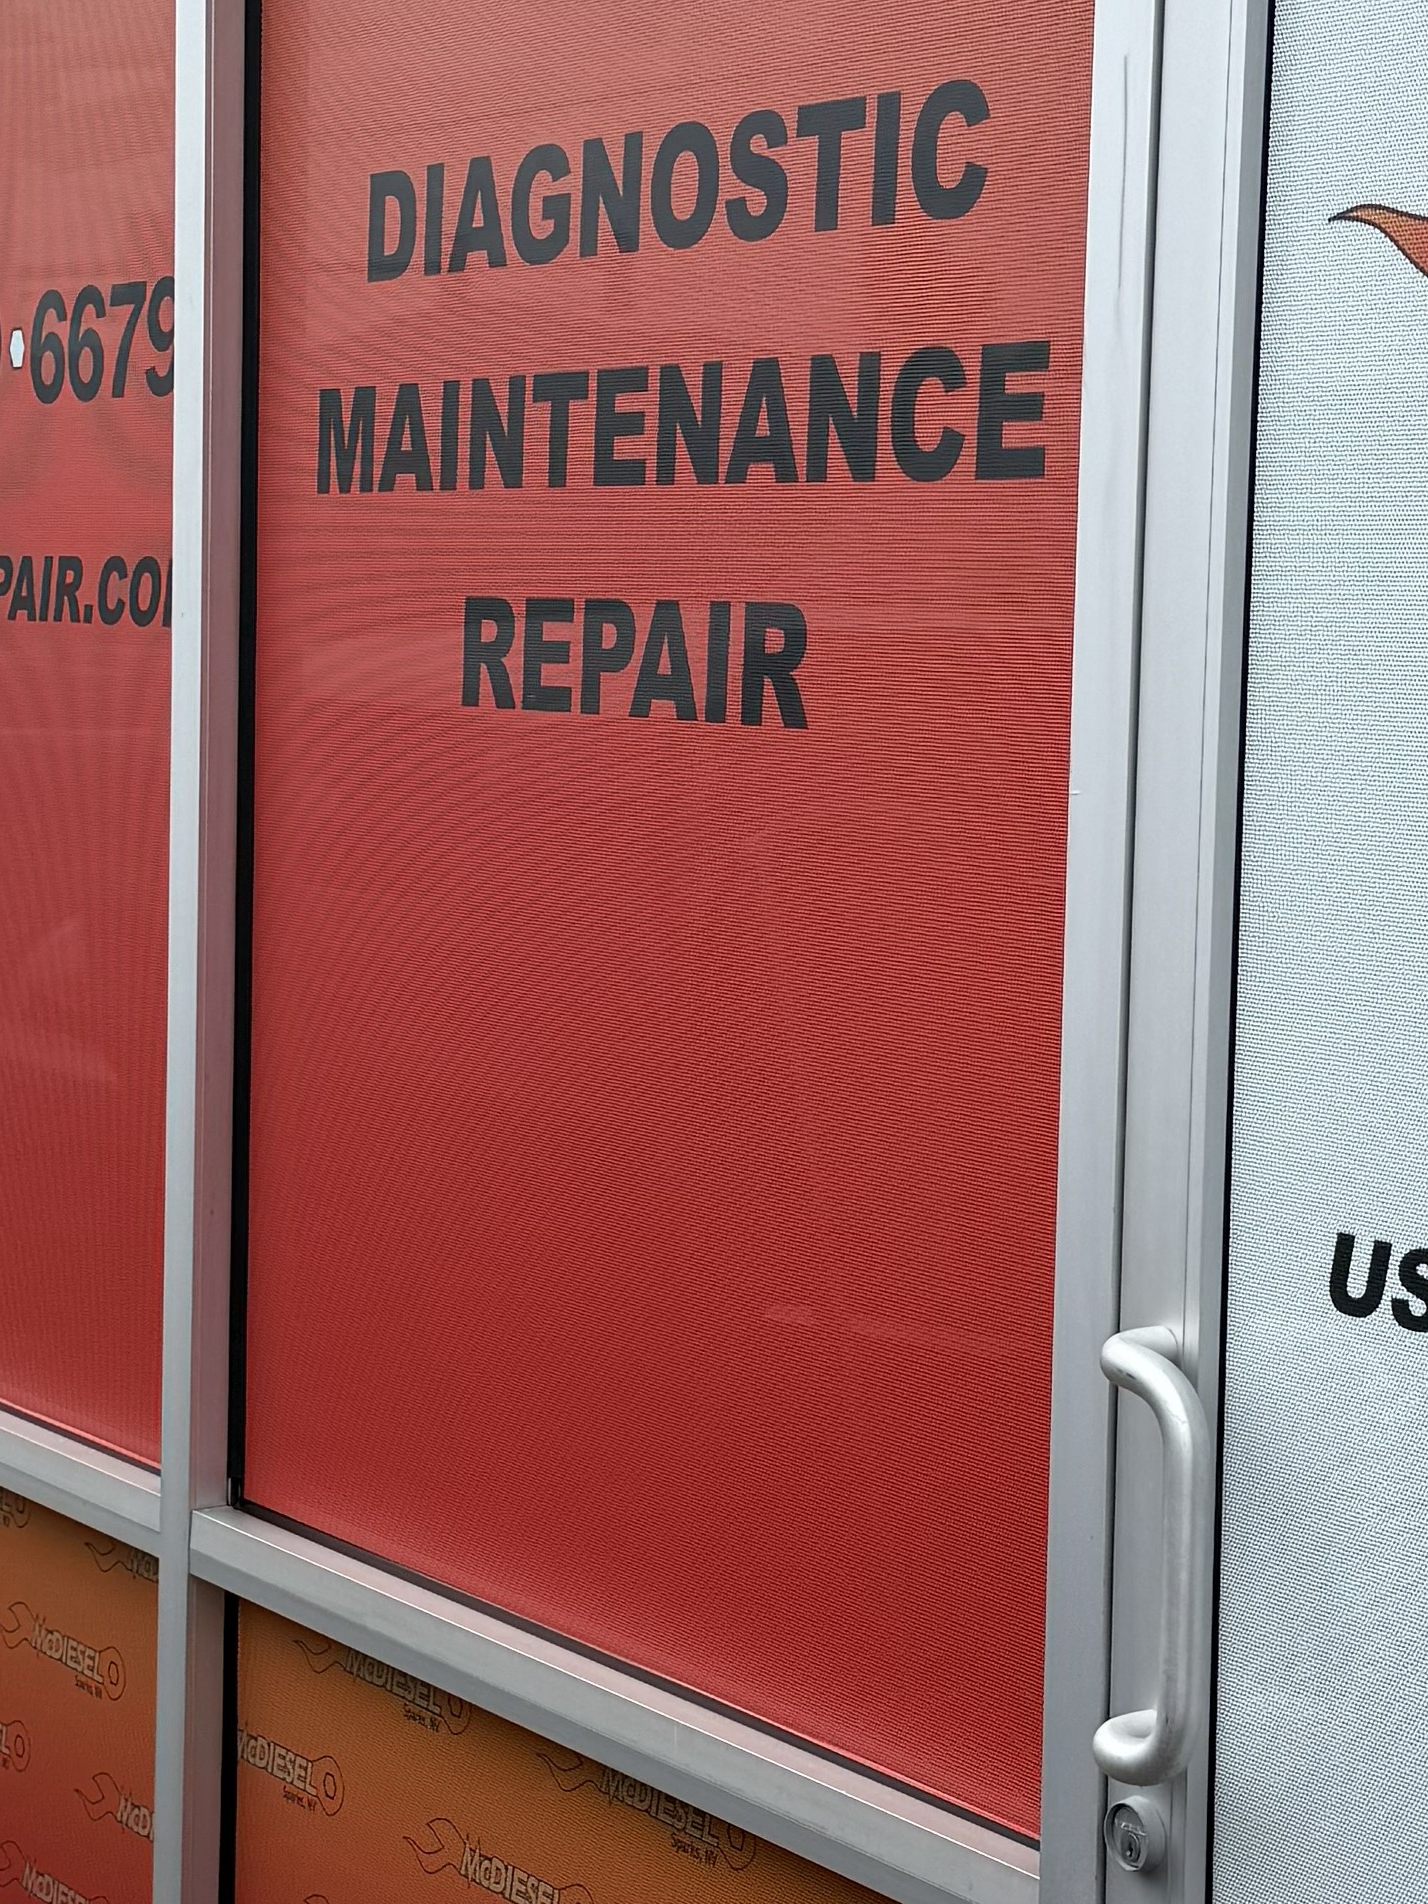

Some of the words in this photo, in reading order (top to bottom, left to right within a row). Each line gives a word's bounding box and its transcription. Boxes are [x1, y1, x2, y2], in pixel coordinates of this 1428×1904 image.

[367, 79, 990, 283] DIAGNOSTIC
[317, 341, 1051, 494] MAINTENANCE
[461, 596, 809, 730] REPAIR
